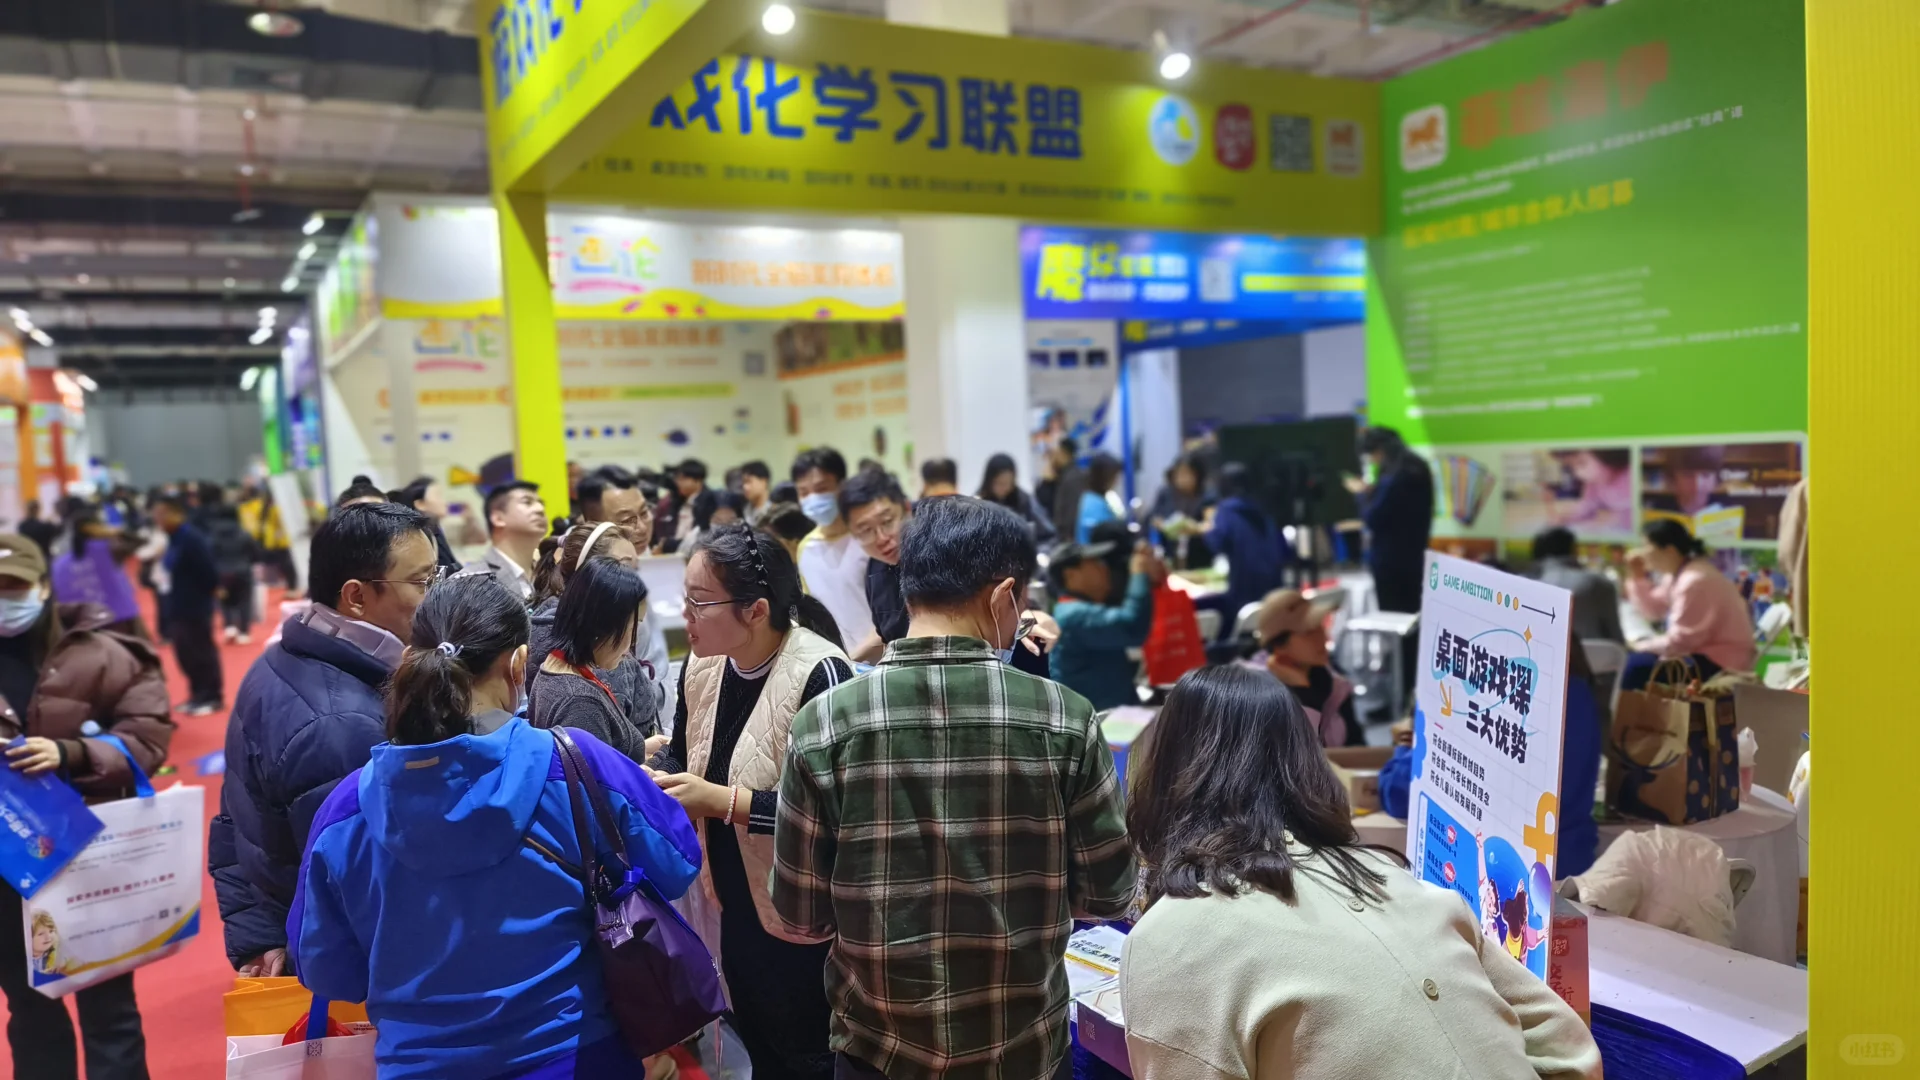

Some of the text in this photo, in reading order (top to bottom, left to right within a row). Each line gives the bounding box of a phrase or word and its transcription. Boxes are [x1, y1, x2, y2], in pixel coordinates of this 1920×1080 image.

[1443, 573, 1460, 591] GAME
[1460, 579, 1494, 603] AMBITION
[1435, 628, 1533, 716] 桌面游戏课
[1466, 700, 1528, 764] 三大优势
[1430, 769, 1483, 822] 符合儿童认知发展规律
[1431, 751, 1490, 807] 符合新一代家长教育理念
